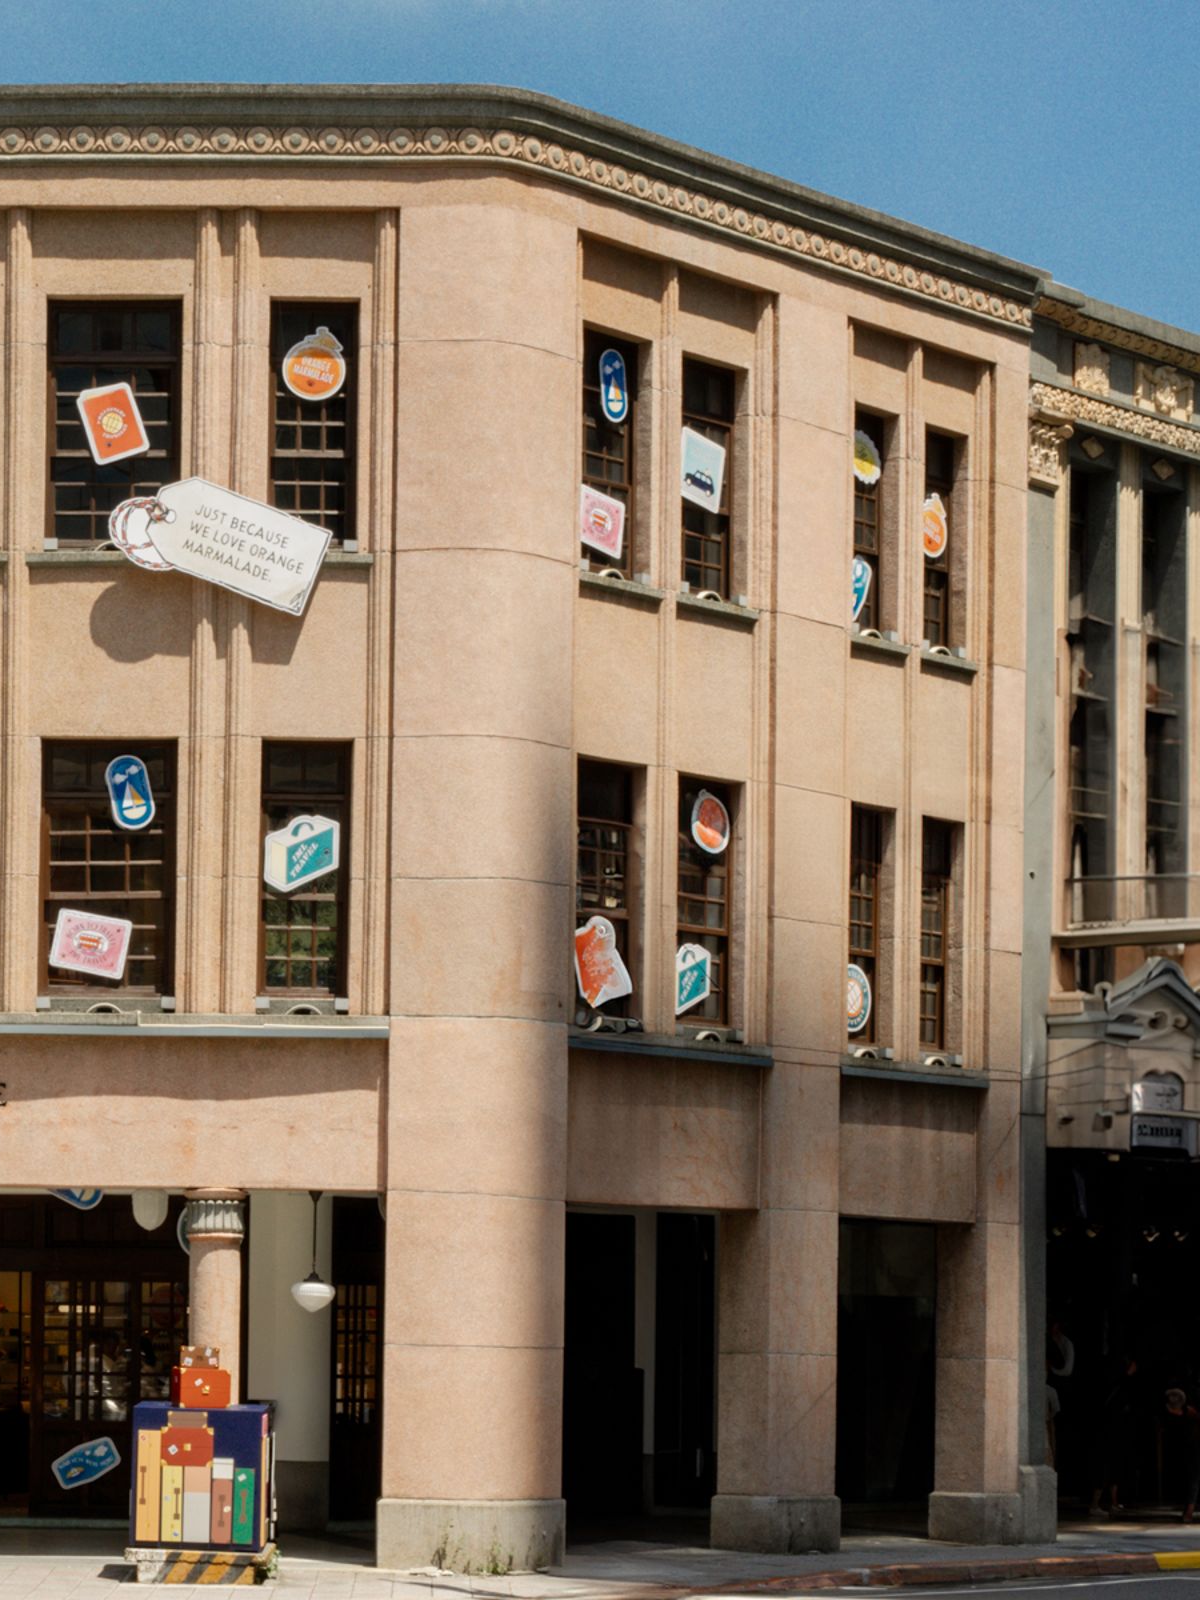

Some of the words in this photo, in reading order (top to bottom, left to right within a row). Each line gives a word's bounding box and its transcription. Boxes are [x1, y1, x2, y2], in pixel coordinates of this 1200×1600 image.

[189, 519, 210, 539] WE
[212, 528, 247, 552] LOVE
[249, 543, 305, 575] ORANGE
[194, 503, 226, 524] JUST
[229, 515, 290, 549] BECAUSE
[182, 538, 272, 583] MARMALADE.
[289, 842, 319, 878] TRAVEL
